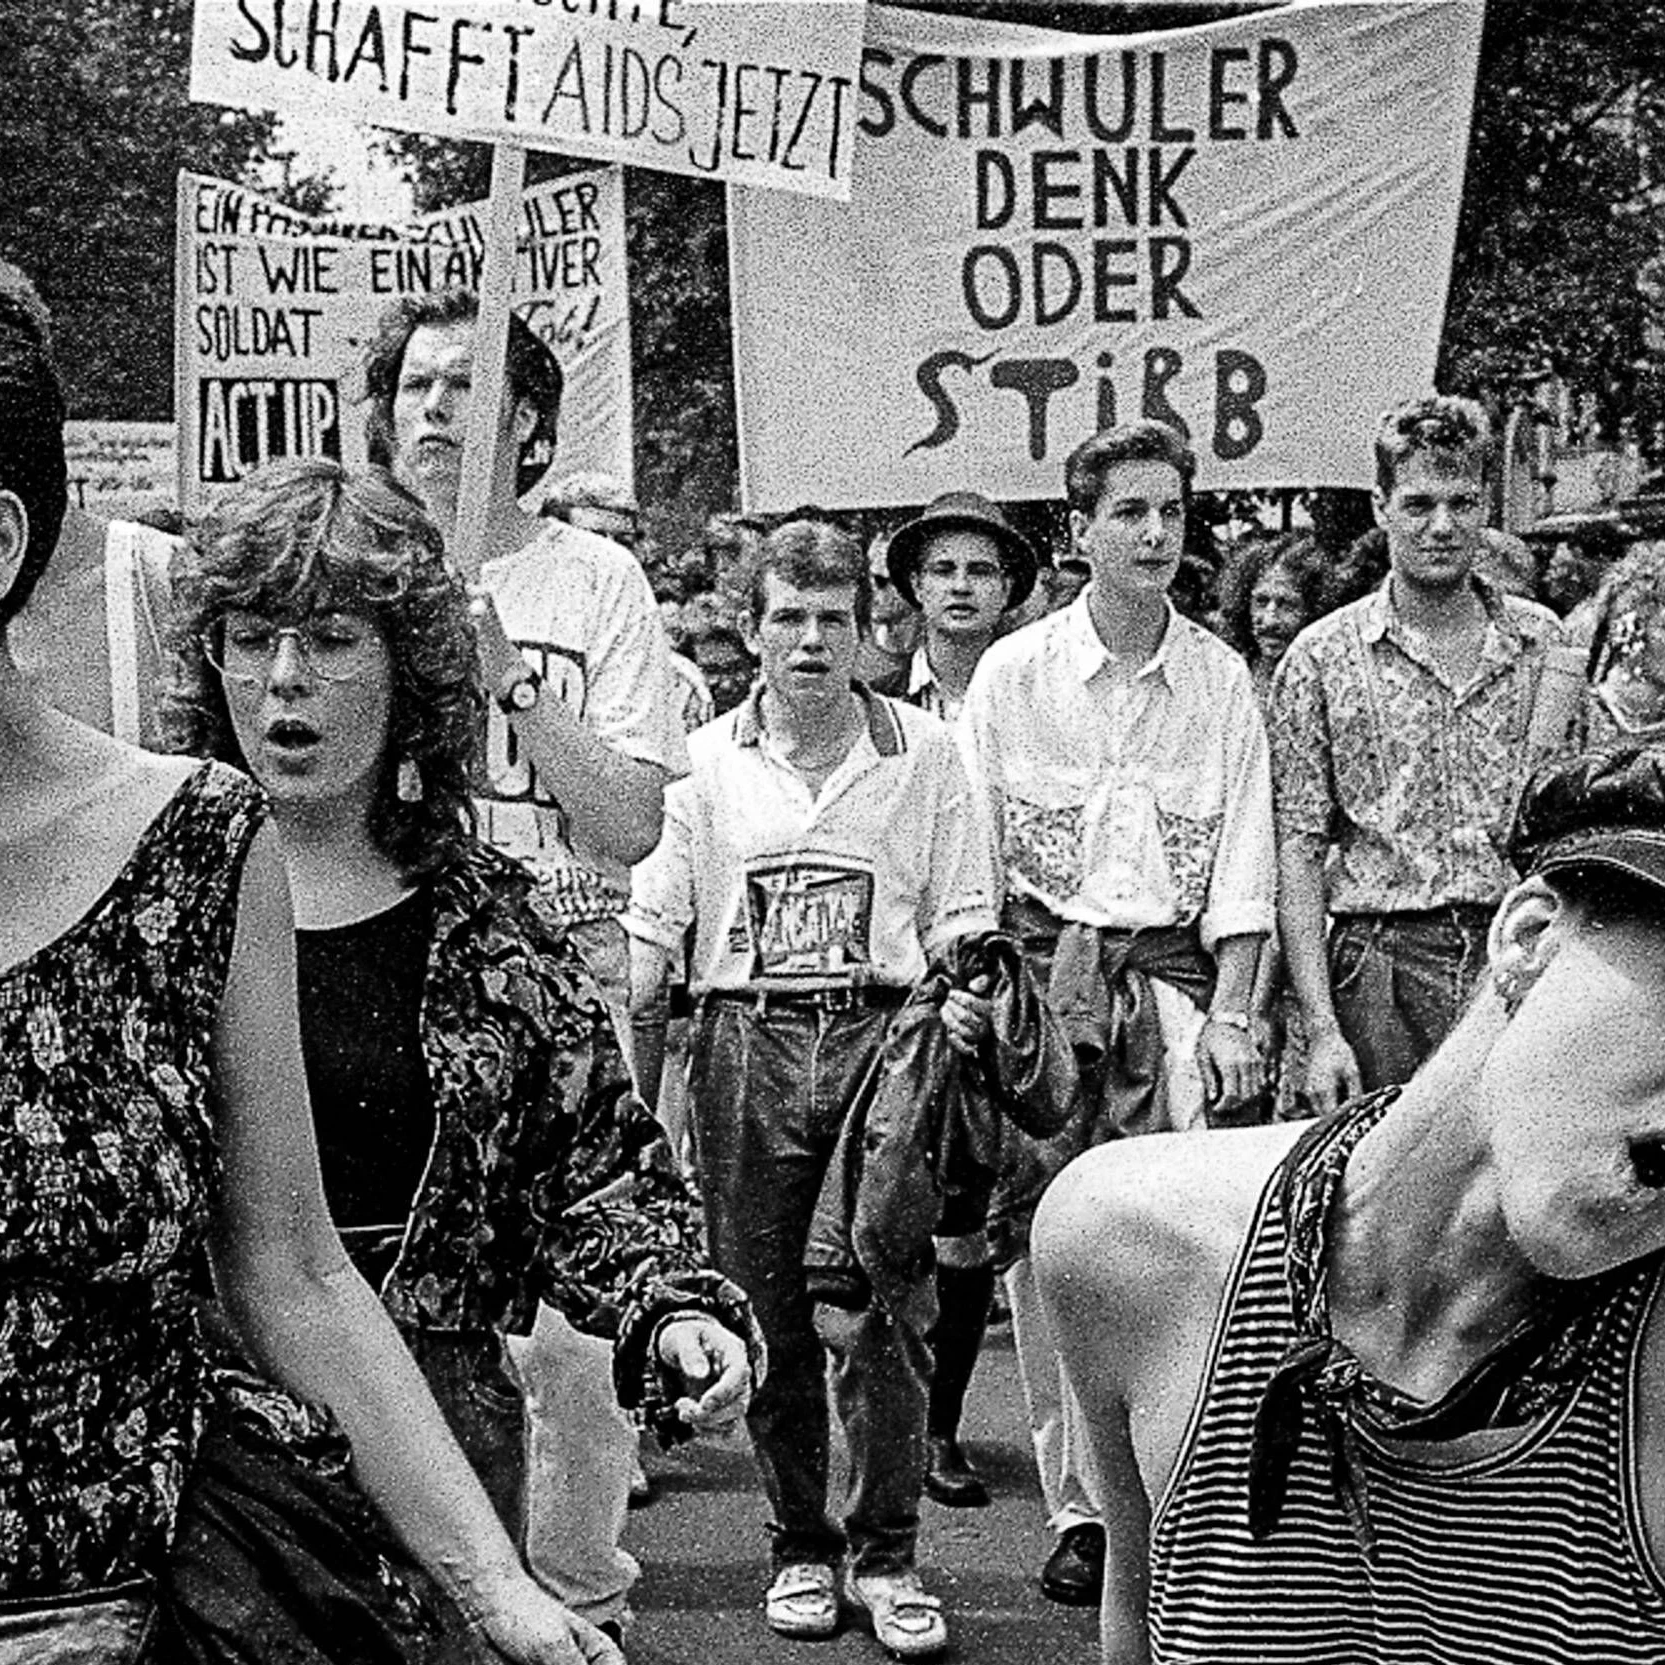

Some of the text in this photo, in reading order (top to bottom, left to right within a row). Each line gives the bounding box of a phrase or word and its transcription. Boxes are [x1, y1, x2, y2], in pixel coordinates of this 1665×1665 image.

[228, 0, 853, 180] SCHAFFT AIDS JETZT
[857, 38, 1301, 141] SCHWULER
[975, 147, 1198, 231] DENK
[195, 240, 239, 296] IST
[256, 244, 339, 295] WIE
[370, 246, 432, 294] EIN
[960, 235, 1204, 330] ODER
[195, 303, 324, 362] SOLDAT
[203, 379, 336, 478] ACT UP
